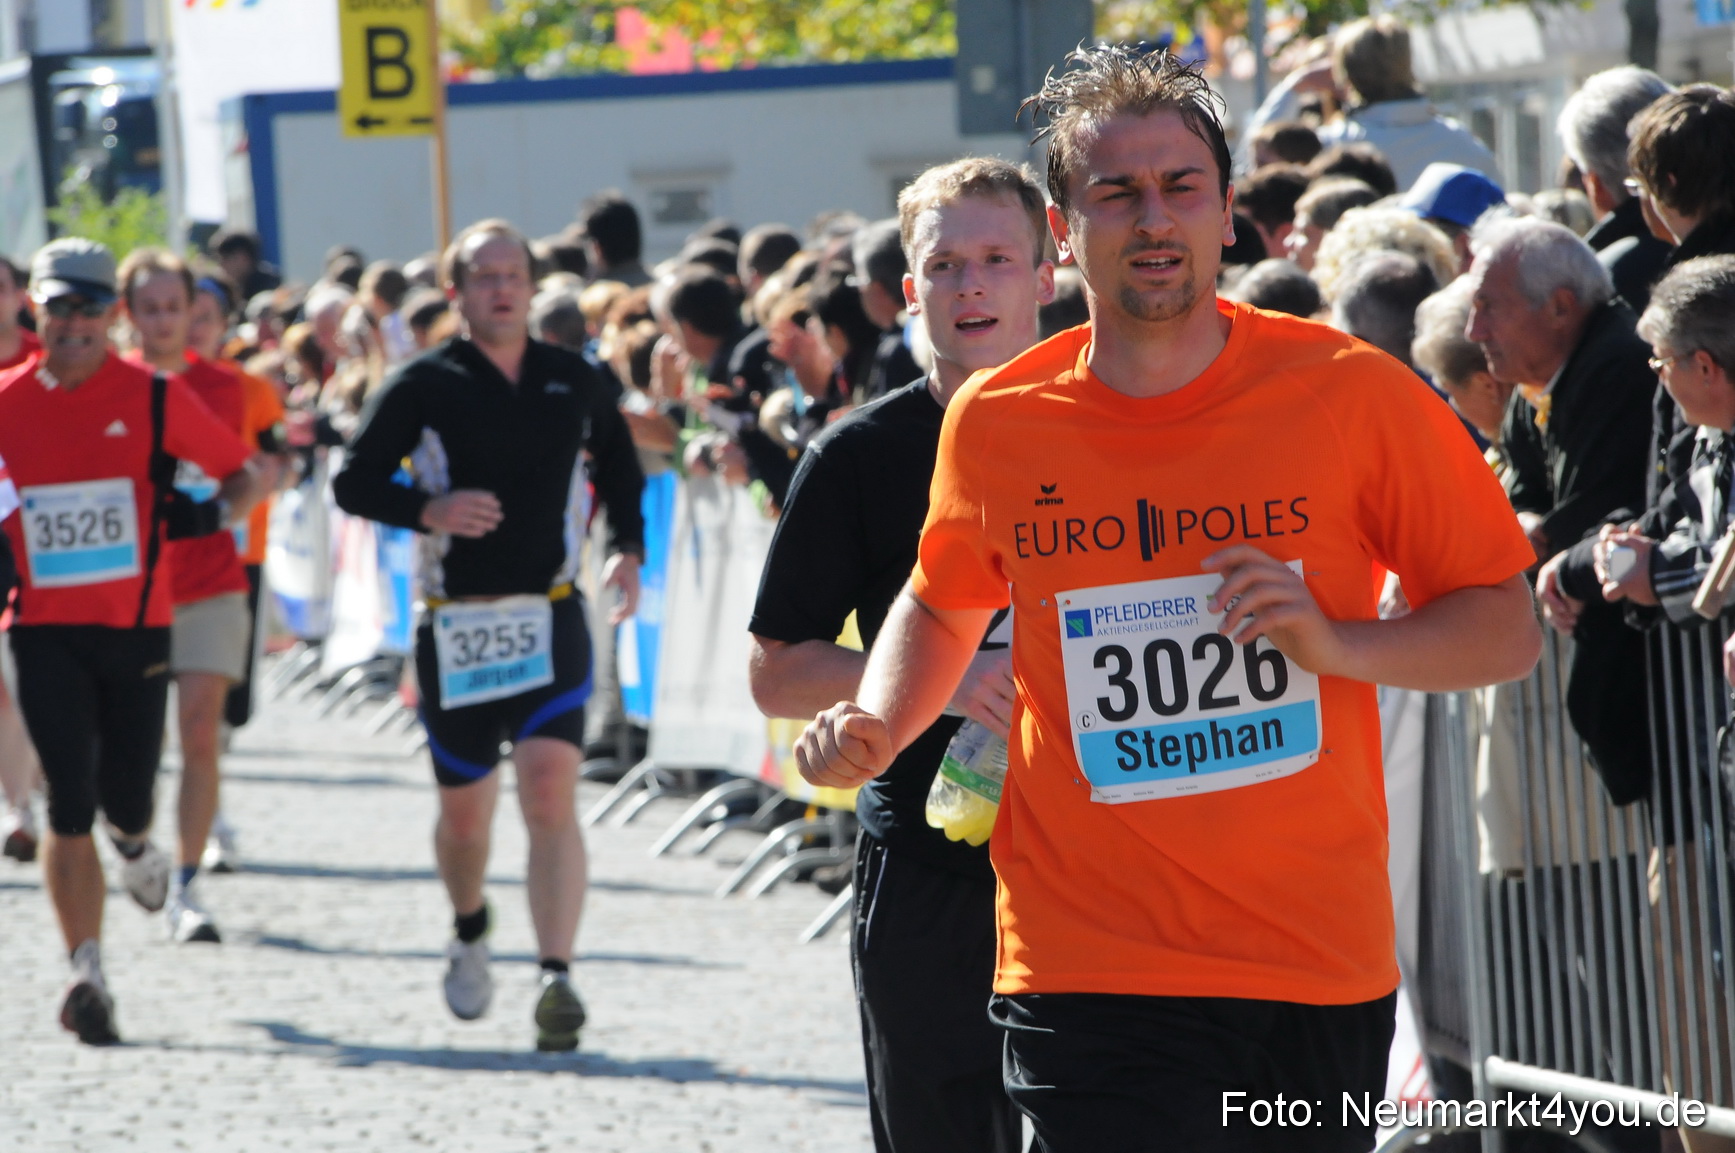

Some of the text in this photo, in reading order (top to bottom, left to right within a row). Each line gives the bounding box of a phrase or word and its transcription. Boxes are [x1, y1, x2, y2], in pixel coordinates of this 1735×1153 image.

[366, 26, 415, 100] B
[1034, 498, 1064, 506] erima
[34, 505, 123, 550] 3526
[1014, 496, 1310, 559] EURO POLES
[1094, 596, 1198, 625] PFLEIDERER
[1096, 617, 1200, 638] AKTIENGESELLSCHAFT
[450, 621, 537, 668] 3255
[1093, 632, 1289, 722] 3026
[1114, 717, 1285, 775] Stephan
